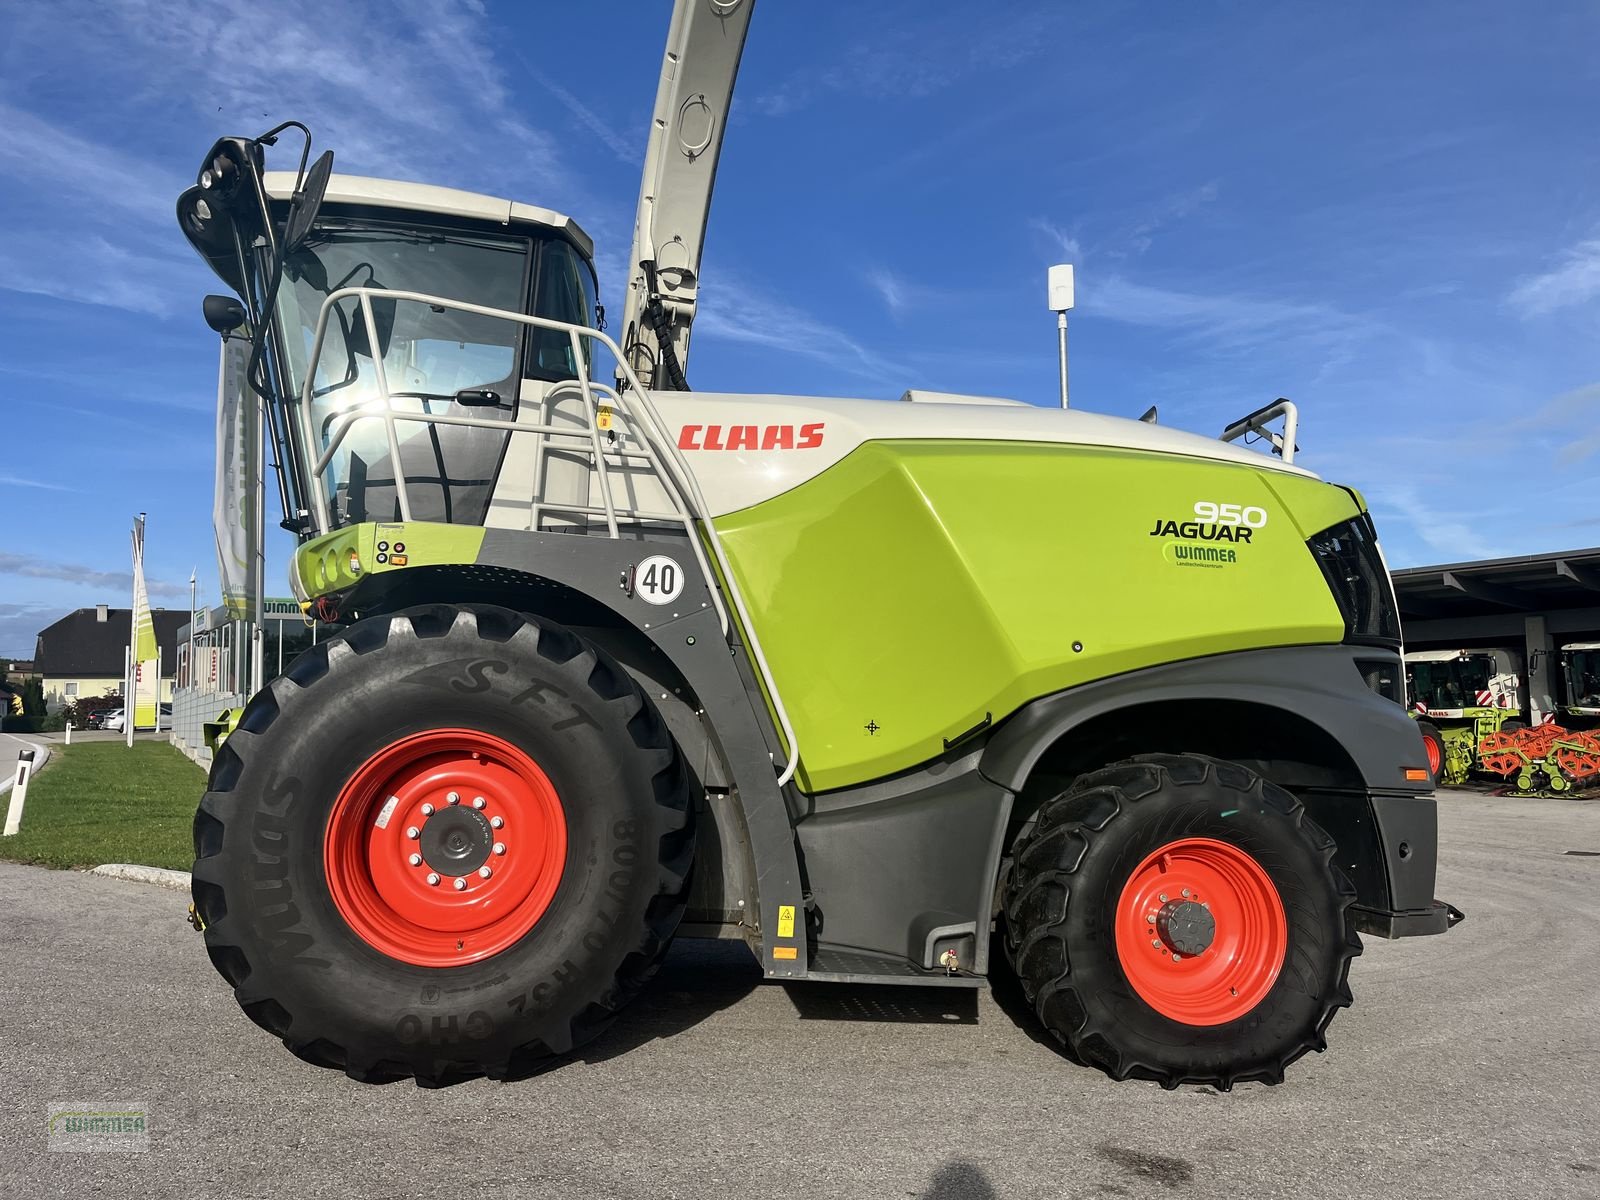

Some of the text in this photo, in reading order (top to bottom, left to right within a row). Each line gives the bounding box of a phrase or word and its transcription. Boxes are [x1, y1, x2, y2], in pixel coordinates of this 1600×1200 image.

[678, 423, 824, 450] CLAAS
[1193, 501, 1267, 528] 950
[1150, 520, 1253, 544] JAGUAR
[1175, 545, 1236, 563] WIMMER
[642, 563, 675, 595] 40
[451, 659, 604, 735] SFT
